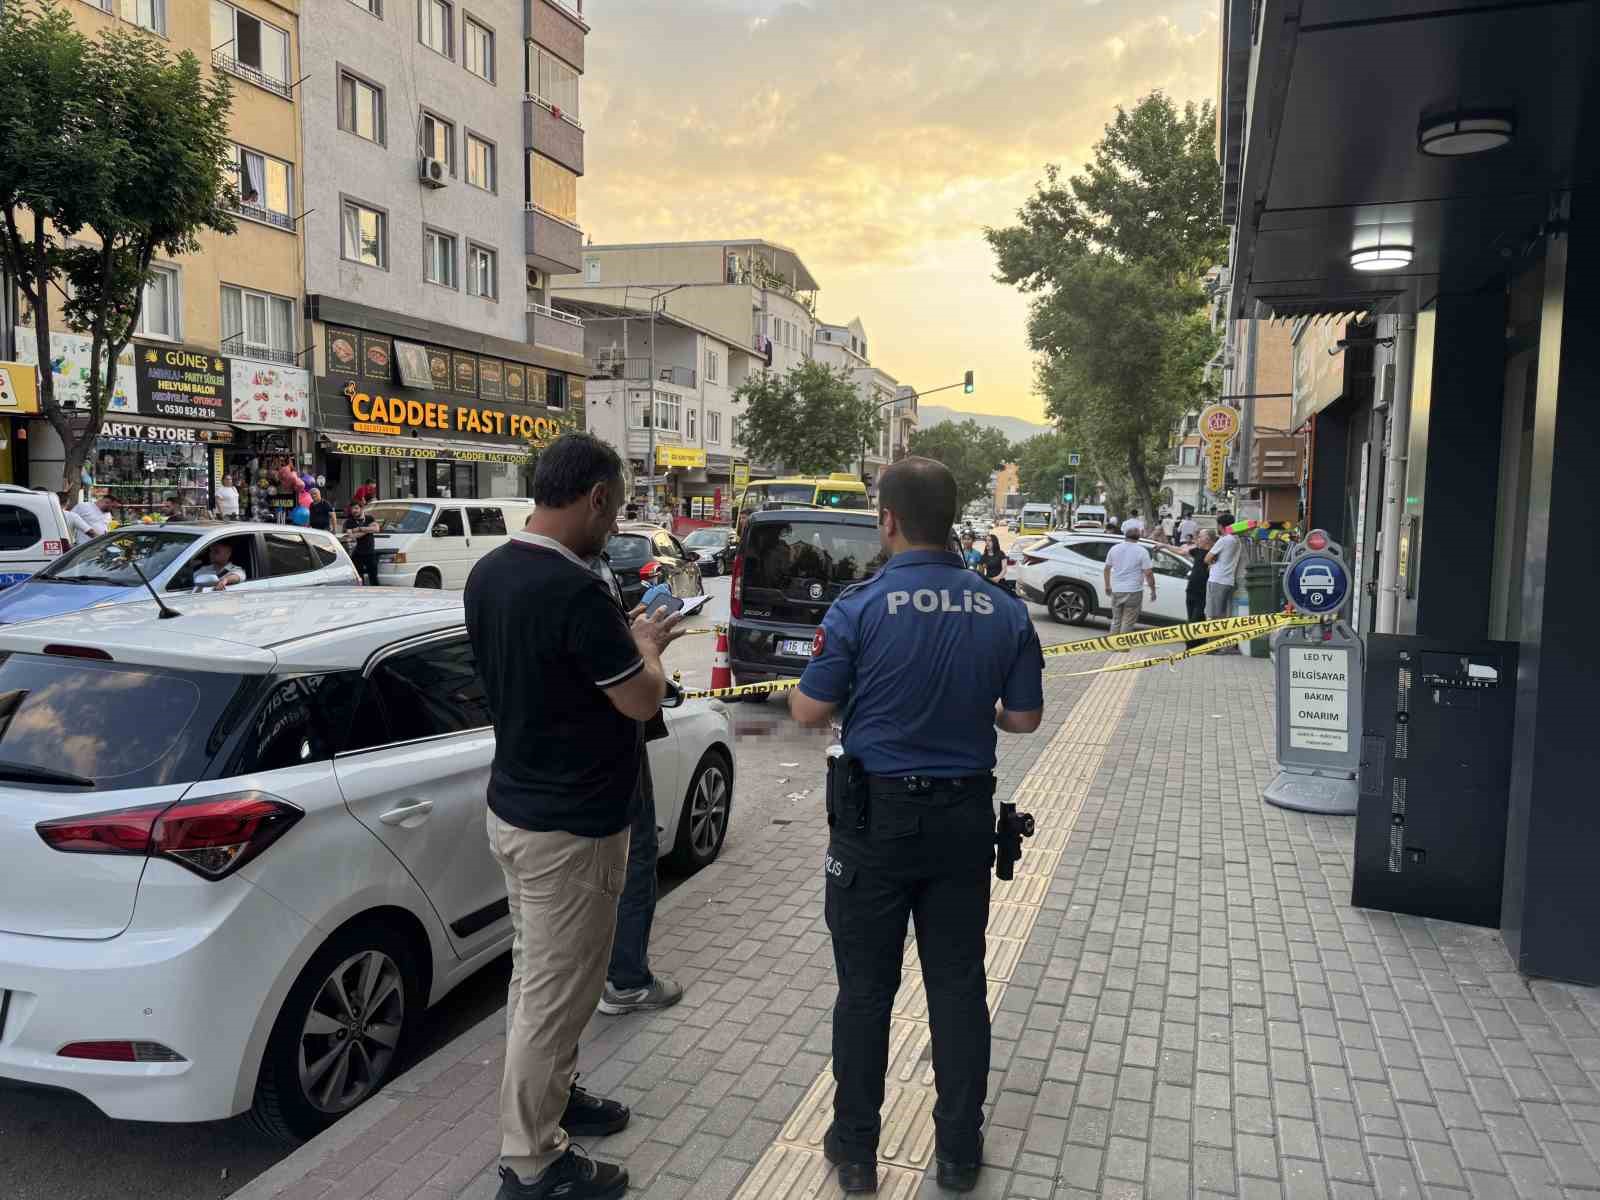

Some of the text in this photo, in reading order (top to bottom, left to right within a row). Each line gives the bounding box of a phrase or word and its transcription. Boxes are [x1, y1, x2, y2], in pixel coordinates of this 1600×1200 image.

[166, 350, 208, 372] GÜNEŞ
[158, 380, 215, 395] HELYUM BALON
[164, 405, 184, 414] 0530
[352, 393, 449, 429] CADDEE
[456, 406, 505, 434] FAST
[511, 415, 560, 440] FOOD
[100, 422, 143, 438] ARTY
[147, 426, 196, 441] STORE
[341, 443, 436, 458] CADDEE FAST FOOD
[886, 588, 994, 615] POLİS
[1303, 653, 1333, 662] LED TV
[1304, 692, 1334, 702] BAKIM
[1298, 710, 1339, 721] ONARIM
